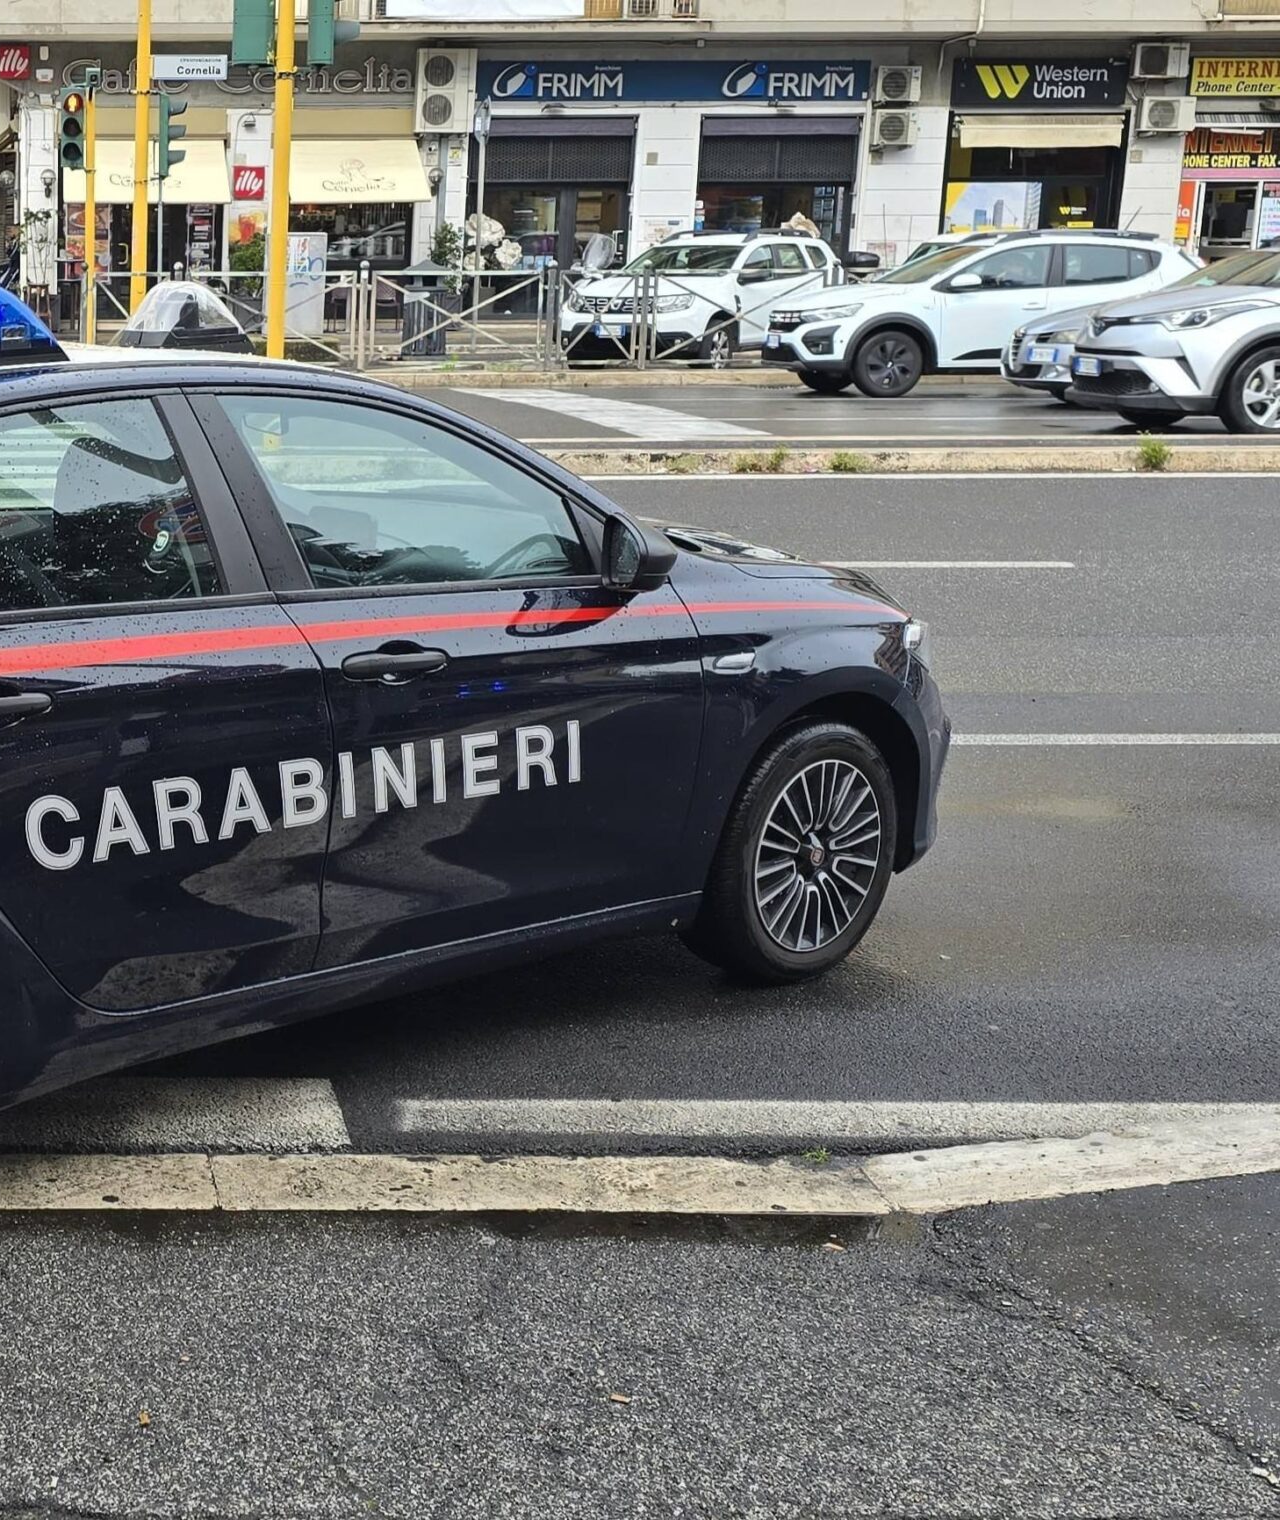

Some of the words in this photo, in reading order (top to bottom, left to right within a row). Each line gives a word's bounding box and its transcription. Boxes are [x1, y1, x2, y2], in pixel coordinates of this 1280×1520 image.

[0, 49, 29, 77] illy
[176, 65, 222, 75] Cornelia
[215, 56, 415, 94] Conelia
[1034, 64, 1109, 81] Western
[537, 72, 624, 97] FRIMM
[767, 72, 855, 97] FRIMM
[1033, 81, 1086, 99] Union
[1194, 81, 1232, 93] Phone
[1235, 81, 1277, 93] Center
[1185, 127, 1274, 153] NTERNET
[1183, 154, 1209, 168] HONE
[1211, 154, 1251, 168] CENTER
[1257, 154, 1277, 168] FAX
[235, 170, 263, 196] illy
[25, 720, 581, 870] CARABINIERI
